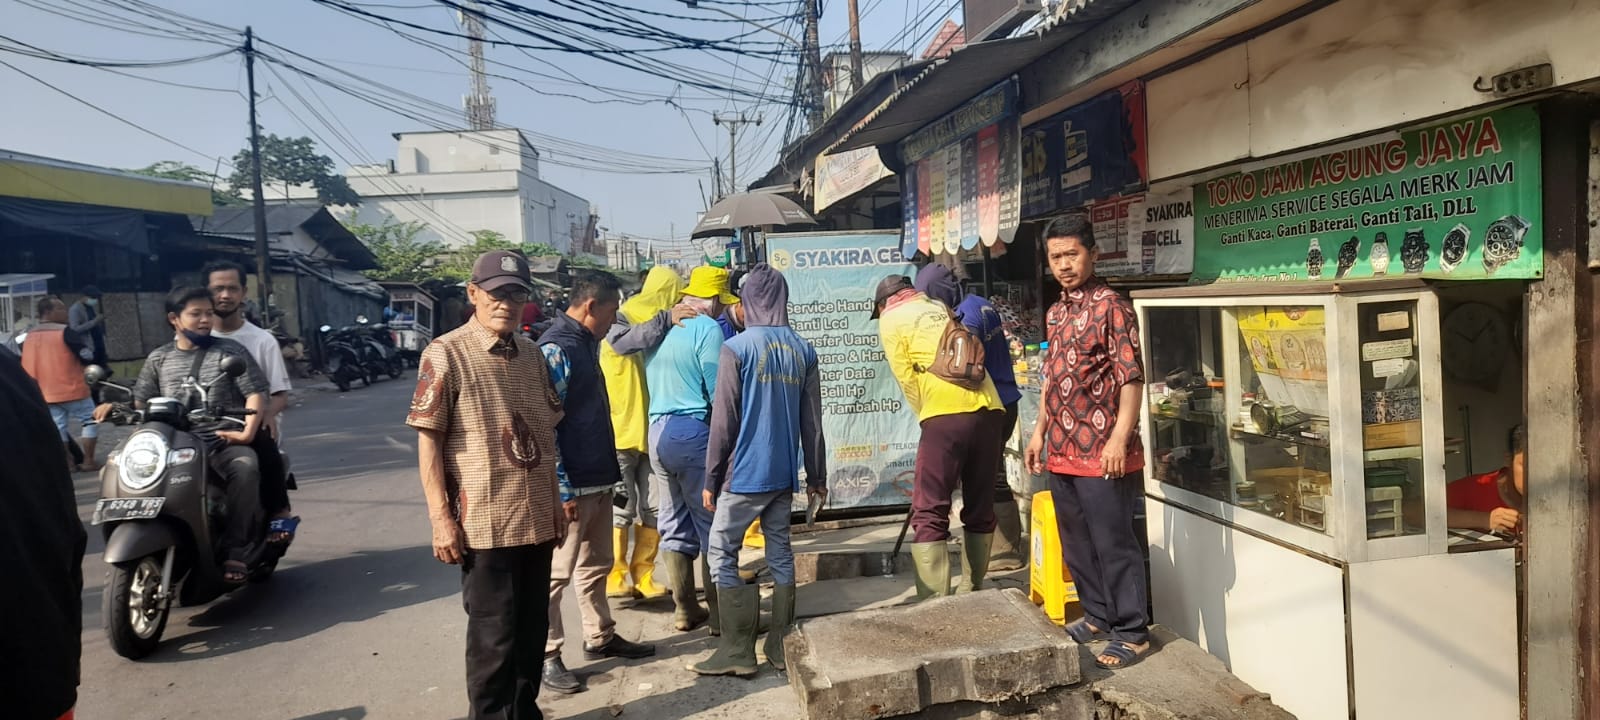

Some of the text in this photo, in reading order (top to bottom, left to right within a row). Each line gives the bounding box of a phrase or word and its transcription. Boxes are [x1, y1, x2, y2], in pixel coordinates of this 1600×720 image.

[1207, 117, 1501, 208] TOKO JAM AGUNG JAYA
[1204, 161, 1514, 229] MENERIMA SERVICE SEGALA MERK JAM
[1146, 201, 1193, 223] SYAKIRA
[1221, 197, 1477, 245] Ganti Kaca, Ganti Baterai, Ganti Tali, DLL
[1157, 229, 1182, 246] CELL
[794, 248, 874, 268] SYAKIRA
[786, 300, 834, 314] Service
[823, 316, 848, 330] Lcd
[807, 333, 878, 347] nsfer Uang
[848, 351, 858, 362] &
[845, 367, 875, 380] Data
[820, 385, 865, 399] Beli Hp
[828, 400, 879, 414] Tambah
[882, 398, 901, 412] Hp
[835, 476, 871, 489] AXIS
